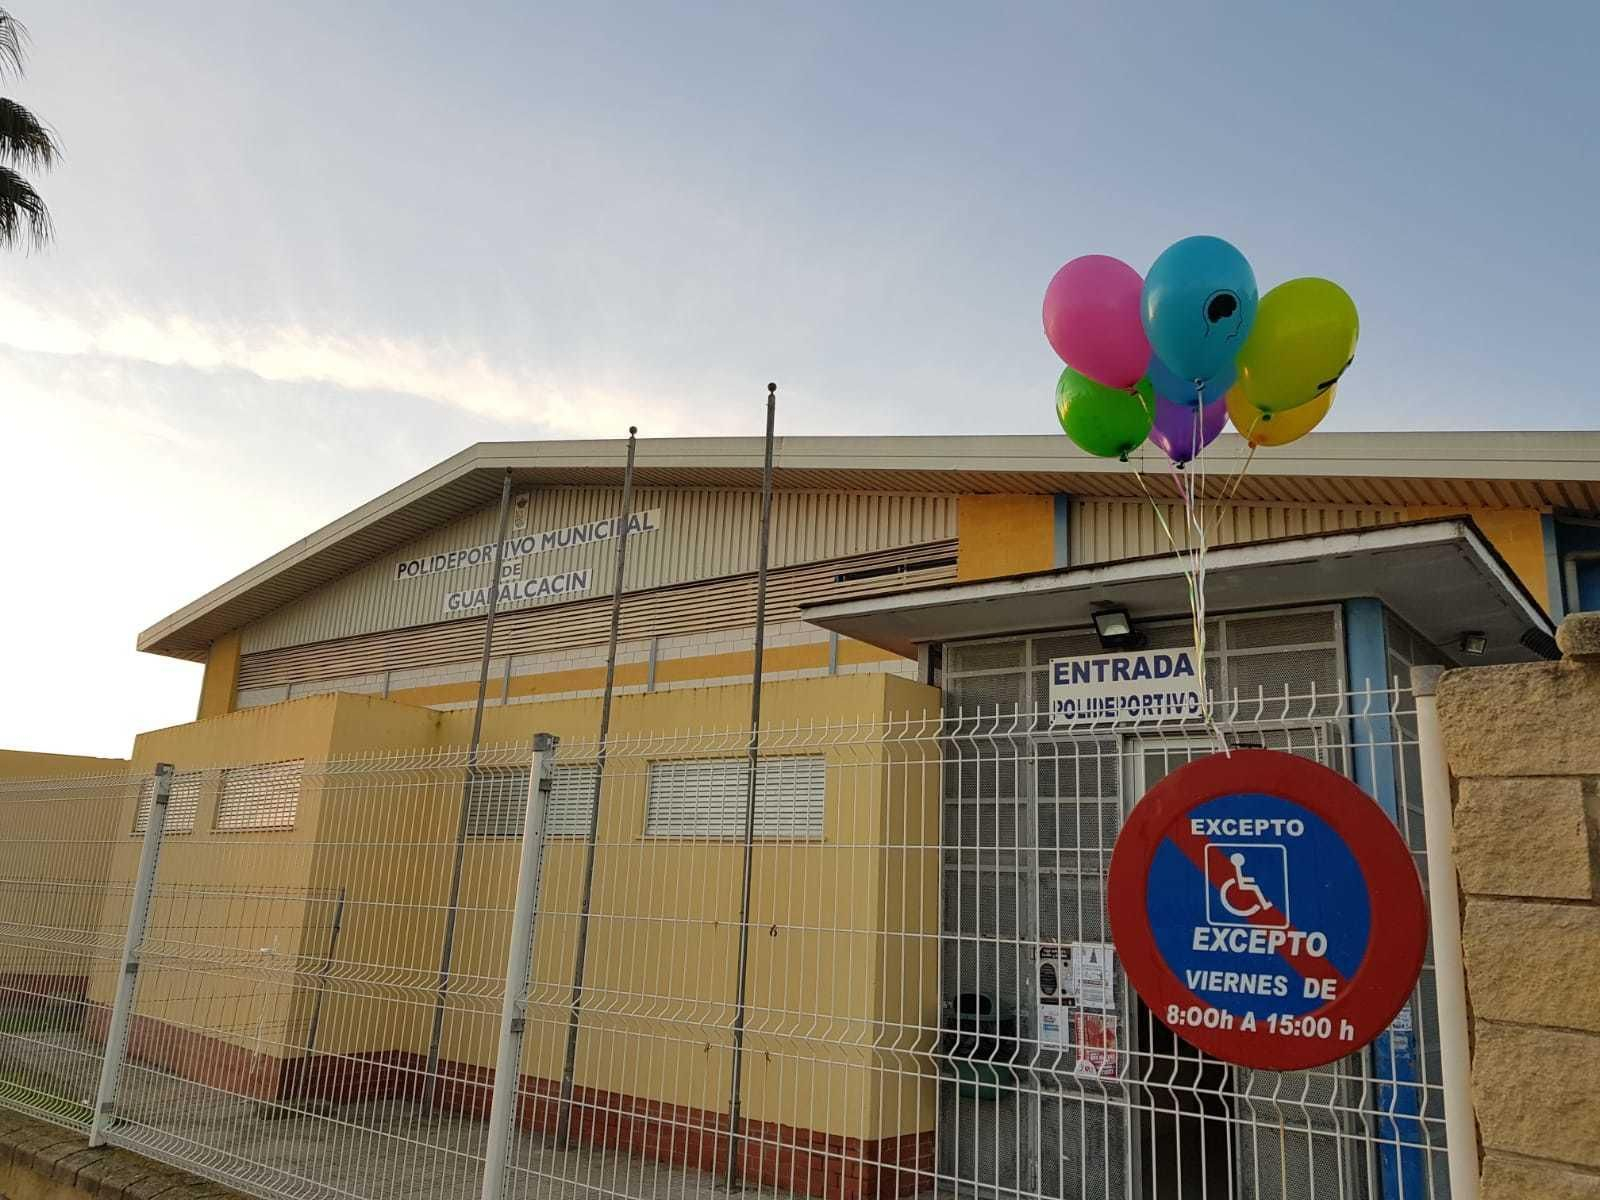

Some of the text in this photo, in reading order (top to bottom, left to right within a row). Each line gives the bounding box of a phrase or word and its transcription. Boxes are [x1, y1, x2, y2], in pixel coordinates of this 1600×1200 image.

[502, 563, 521, 578] DE
[1054, 653, 1195, 685] ENTRADA
[1190, 818, 1305, 837] EXCEPTO
[1192, 926, 1328, 957] EXCEPTO
[1185, 969, 1337, 1000] VIERNES DE
[1239, 1013, 1257, 1032] A
[1266, 1013, 1331, 1039] 15:00
[1339, 1019, 1355, 1041] h
